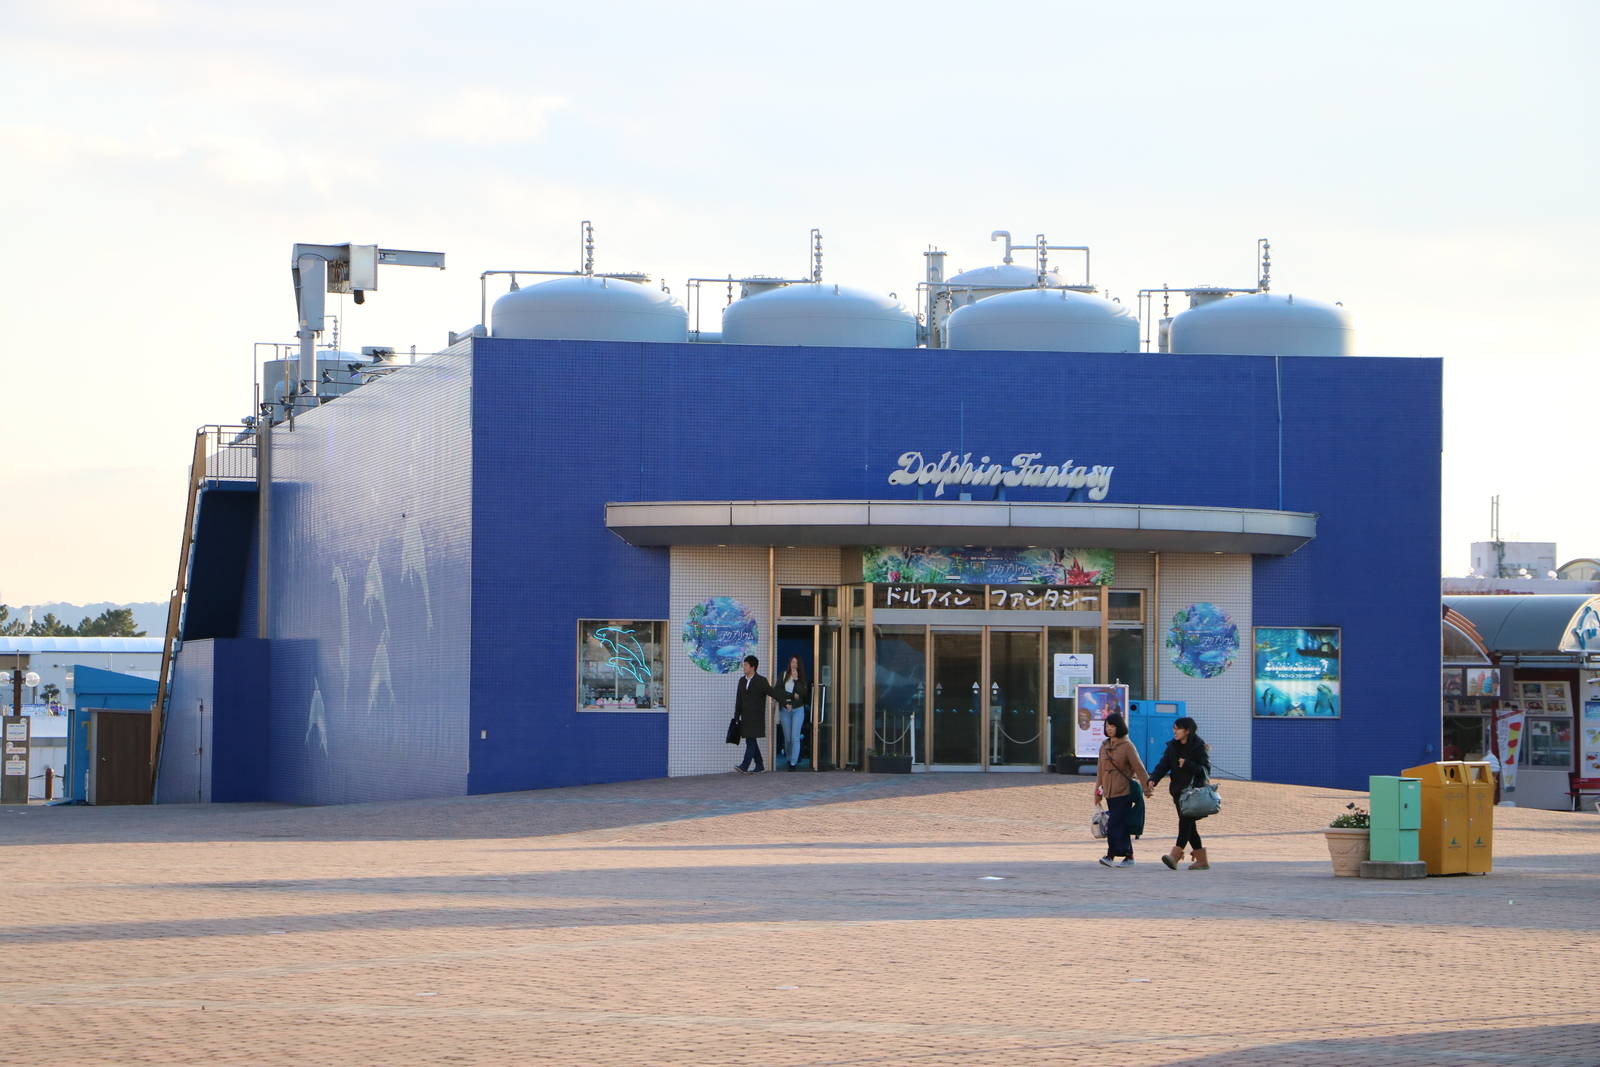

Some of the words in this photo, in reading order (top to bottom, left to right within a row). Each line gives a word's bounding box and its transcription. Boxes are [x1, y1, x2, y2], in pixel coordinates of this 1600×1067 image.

[888, 450, 1003, 497] Dolphin
[1003, 452, 1114, 500] Fantasy
[887, 586, 971, 606] ドルフィン
[991, 588, 1098, 608] ファンタジー
